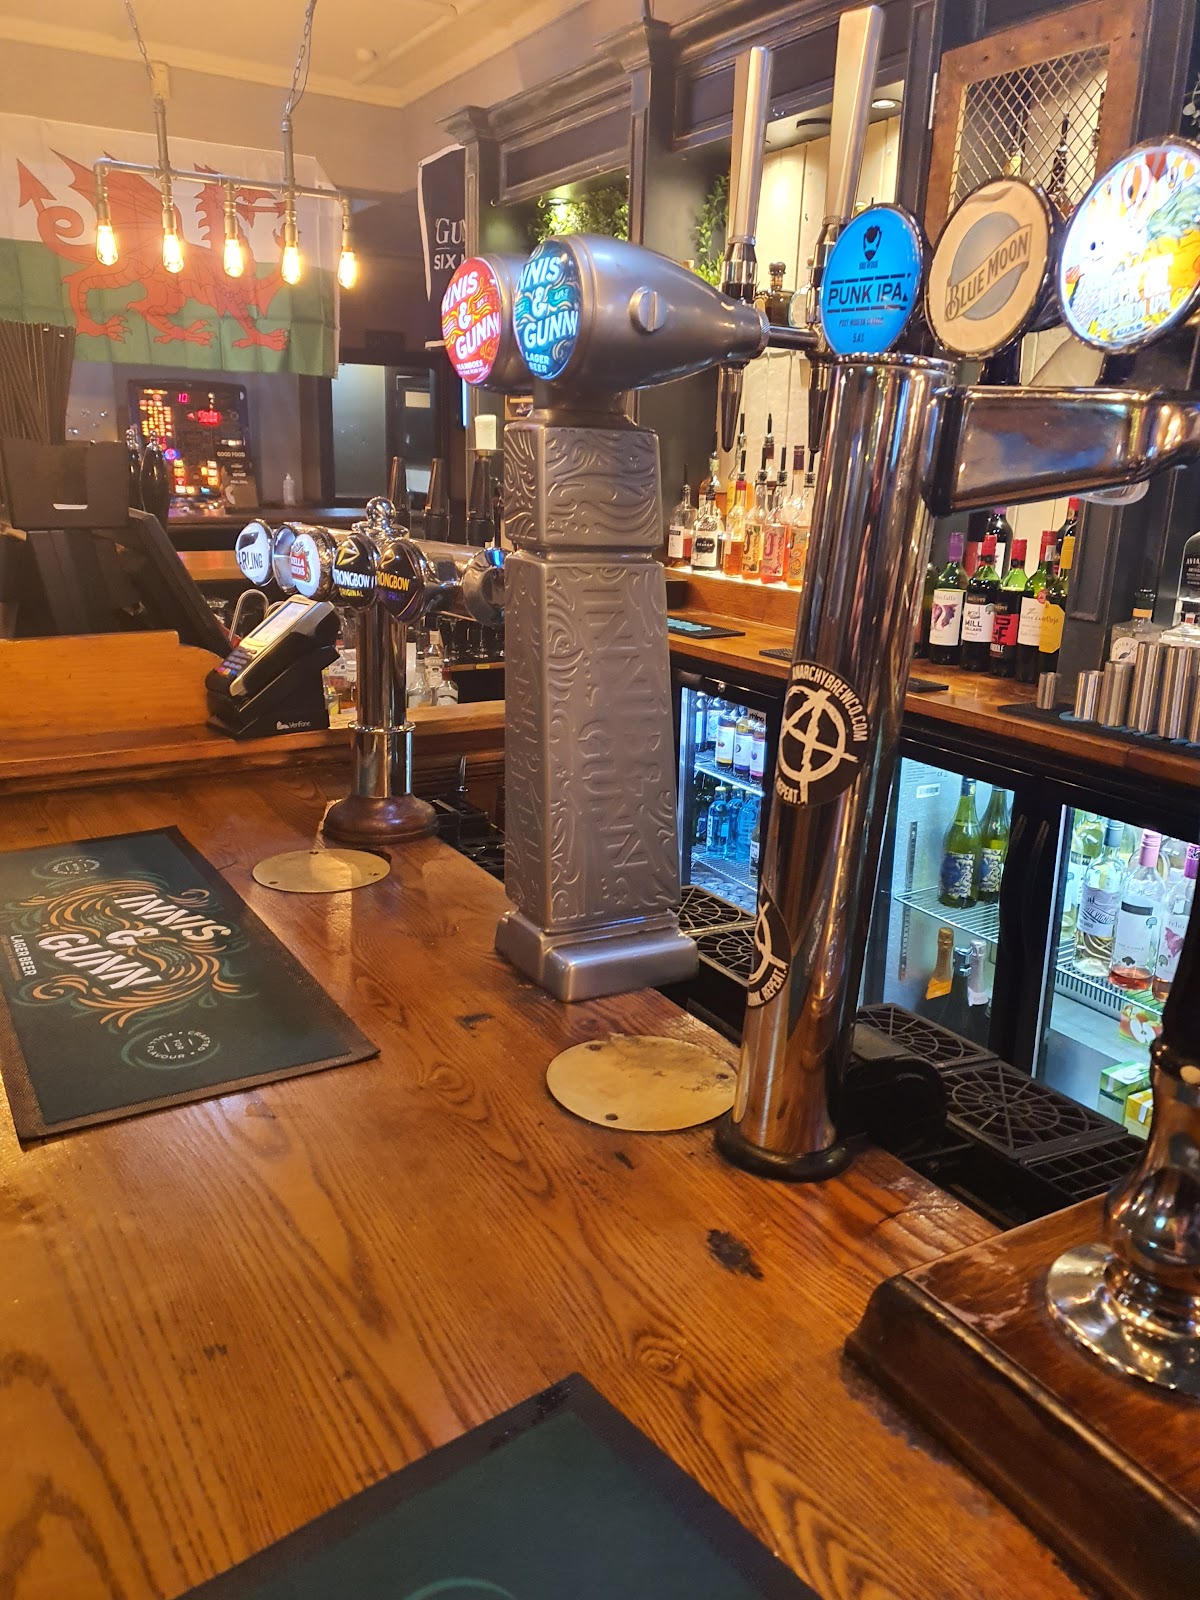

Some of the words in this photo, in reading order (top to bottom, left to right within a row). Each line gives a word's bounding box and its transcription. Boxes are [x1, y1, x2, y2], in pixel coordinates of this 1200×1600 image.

[434, 253, 457, 270] SIX
[517, 256, 561, 292] NNIS
[946, 270, 985, 321] BLUE
[987, 231, 1029, 286] MOON
[442, 271, 479, 317] NNIS
[532, 286, 550, 318] &
[828, 285, 872, 306] PUNK
[876, 282, 903, 302] IPA
[458, 301, 473, 330] &
[524, 310, 579, 349] GUNN
[456, 311, 500, 360] GUNN
[525, 351, 550, 365] LAGER
[529, 361, 548, 373] BEER
[964, 619, 983, 629] MILL
[792, 664, 868, 742] ANARCHYBREWCO.COM
[113, 893, 232, 942] INNIS
[10, 934, 30, 958] LAGER
[106, 927, 160, 947] &
[18, 956, 37, 977] BEER
[38, 932, 162, 990] GUNN
